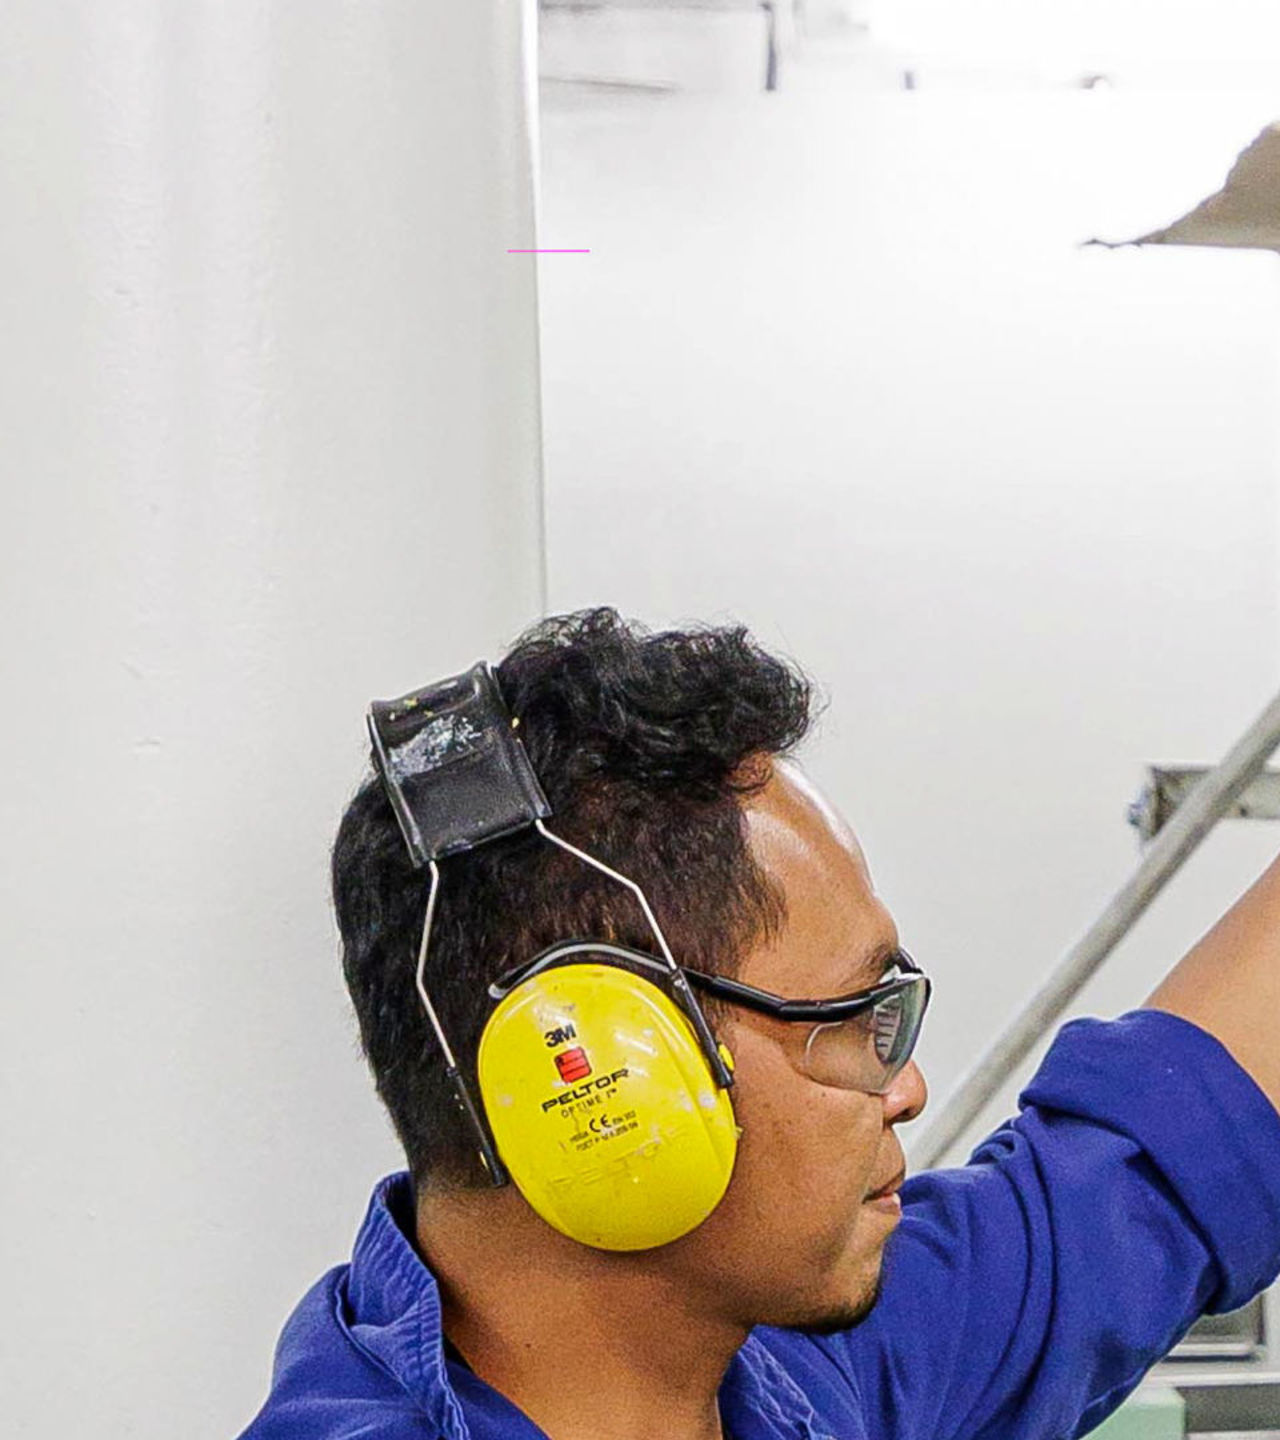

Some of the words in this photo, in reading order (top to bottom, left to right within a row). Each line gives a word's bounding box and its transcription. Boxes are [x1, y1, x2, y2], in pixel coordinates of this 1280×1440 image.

[544, 1024, 577, 1048] 3M
[541, 1068, 629, 1113] PELTOR
[561, 1094, 602, 1118] OPTIME
